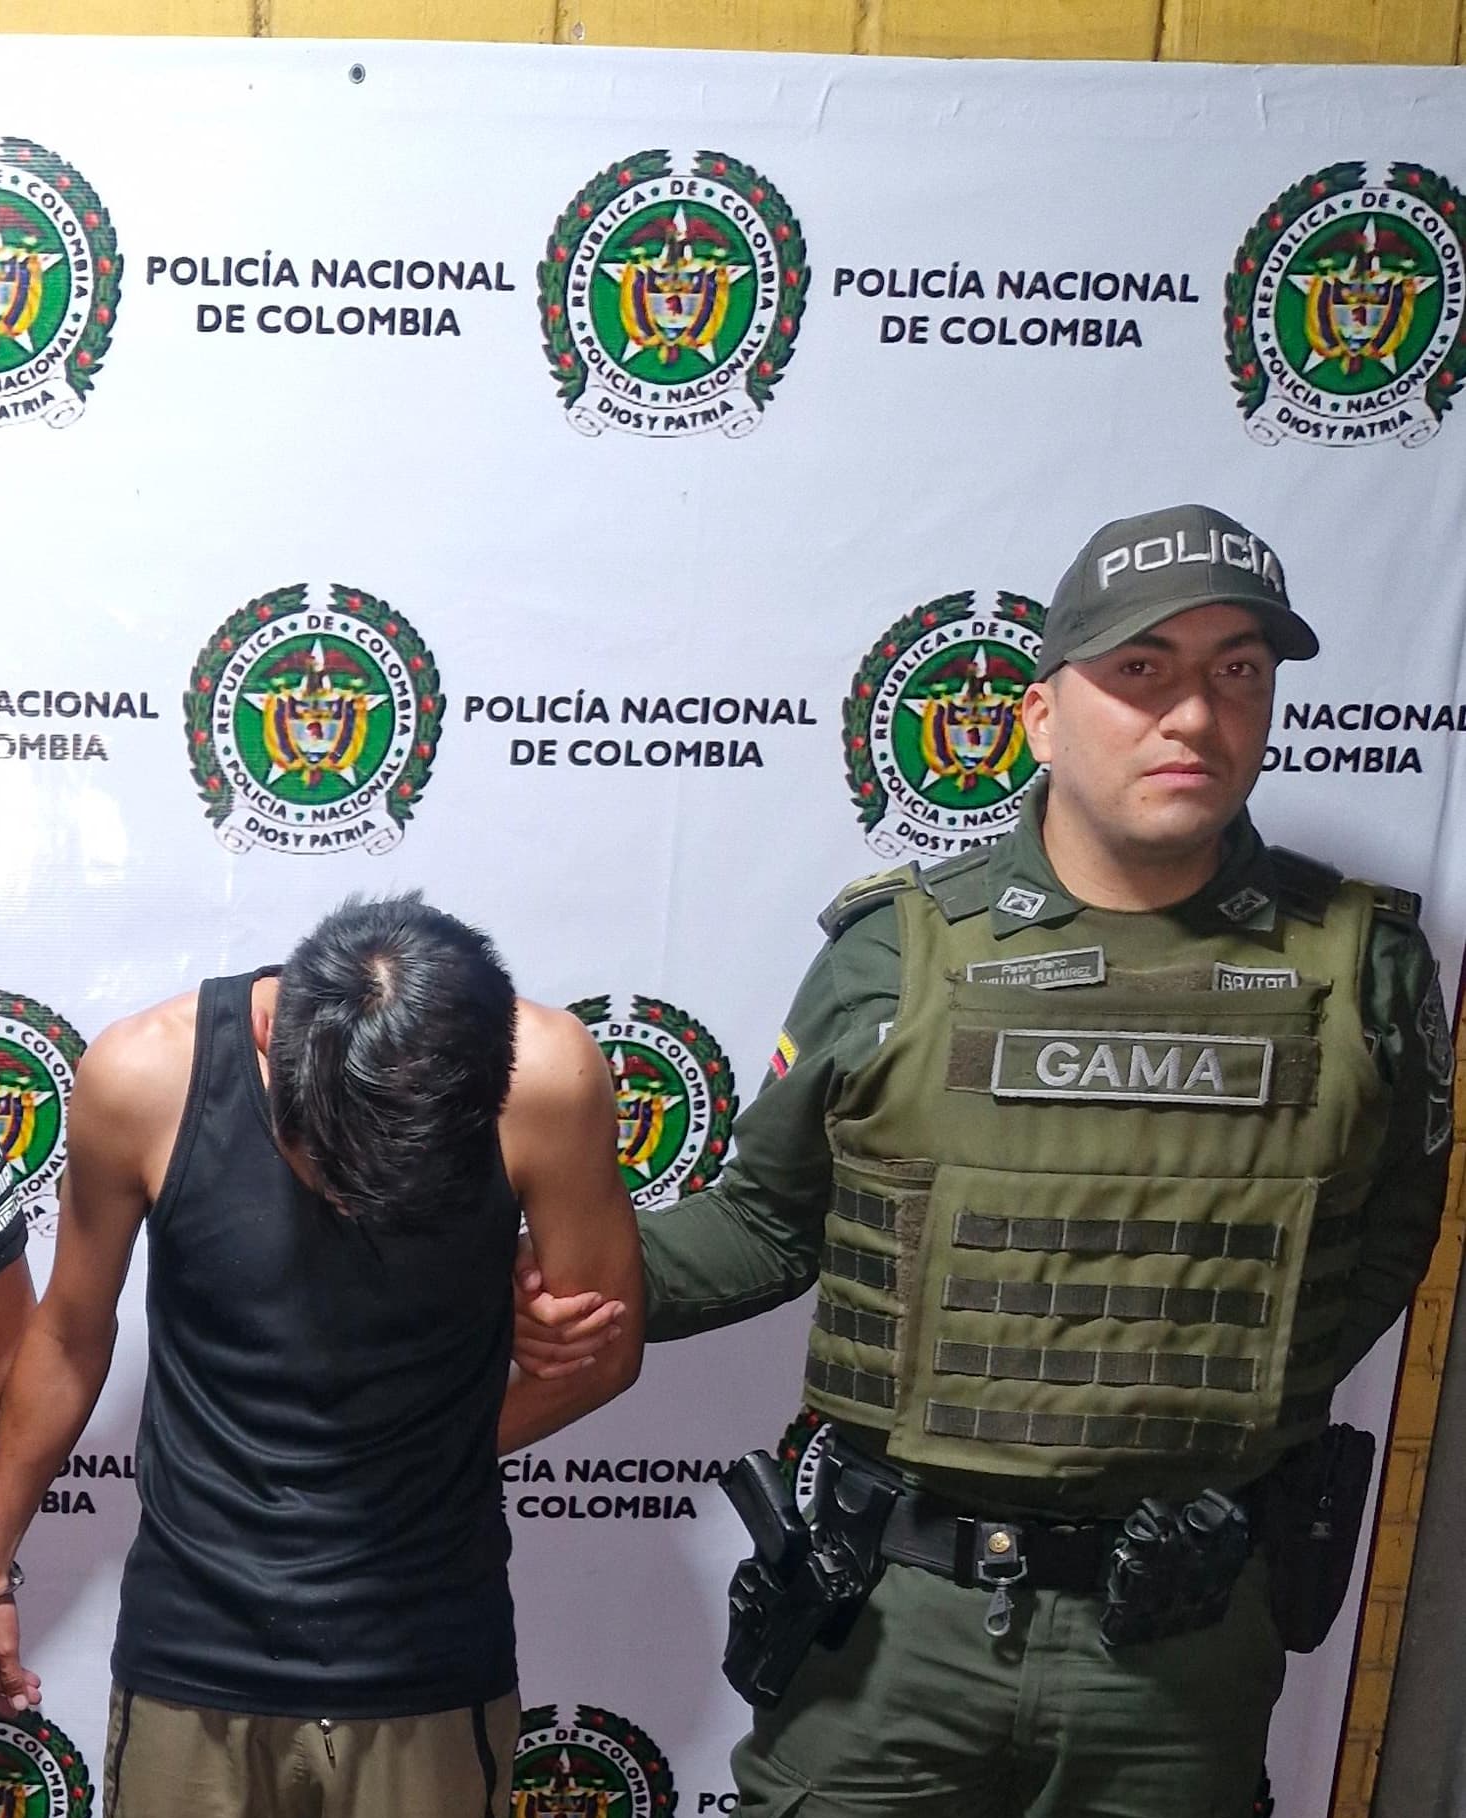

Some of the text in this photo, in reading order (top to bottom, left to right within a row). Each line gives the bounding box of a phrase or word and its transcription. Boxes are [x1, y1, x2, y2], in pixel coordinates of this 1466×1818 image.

[26, 182, 89, 299] COLOMBIA
[670, 180, 699, 196] DE
[719, 194, 775, 310] COLOMBIA
[1362, 192, 1391, 208] DE
[1410, 206, 1462, 321] COLOMBIA
[147, 250, 515, 291] POLICÍA NACIONAL
[834, 262, 1199, 303] POLICÍA NACIONAL
[197, 305, 460, 336] DE COLOMBIA
[881, 316, 1142, 347] DE COLOMBIA
[579, 335, 762, 403] POLICIA NACIONAL
[1262, 345, 1444, 413] POLICIA NACIONAL
[597, 396, 736, 430] DIOS Y PATRIA
[1276, 406, 1414, 440] DIOS Y PATRIA
[972, 621, 1000, 637] DE
[307, 615, 335, 630] DE
[355, 628, 412, 735] COLOMBIA
[465, 689, 817, 725] POLICÍA NACIONAL
[510, 740, 763, 767] DE COLOMBIA
[1261, 745, 1423, 774] OLOMBIA
[225, 759, 400, 823] POLICIA NACIONAL
[880, 764, 1025, 827] POLICIA NACIO
[244, 816, 377, 848] DIOS Y PATRIA
[896, 821, 941, 850] DIOS
[942, 837, 955, 852] Y
[609, 1023, 706, 1133] DE COLOMBIA
[1035, 1041, 1224, 1092] GAMA
[633, 1157, 694, 1205] CIONAL
[517, 1496, 697, 1519] COLOMBIA
[556, 1729, 581, 1741] DE
[12, 1733, 65, 1816] COLOMBIA
